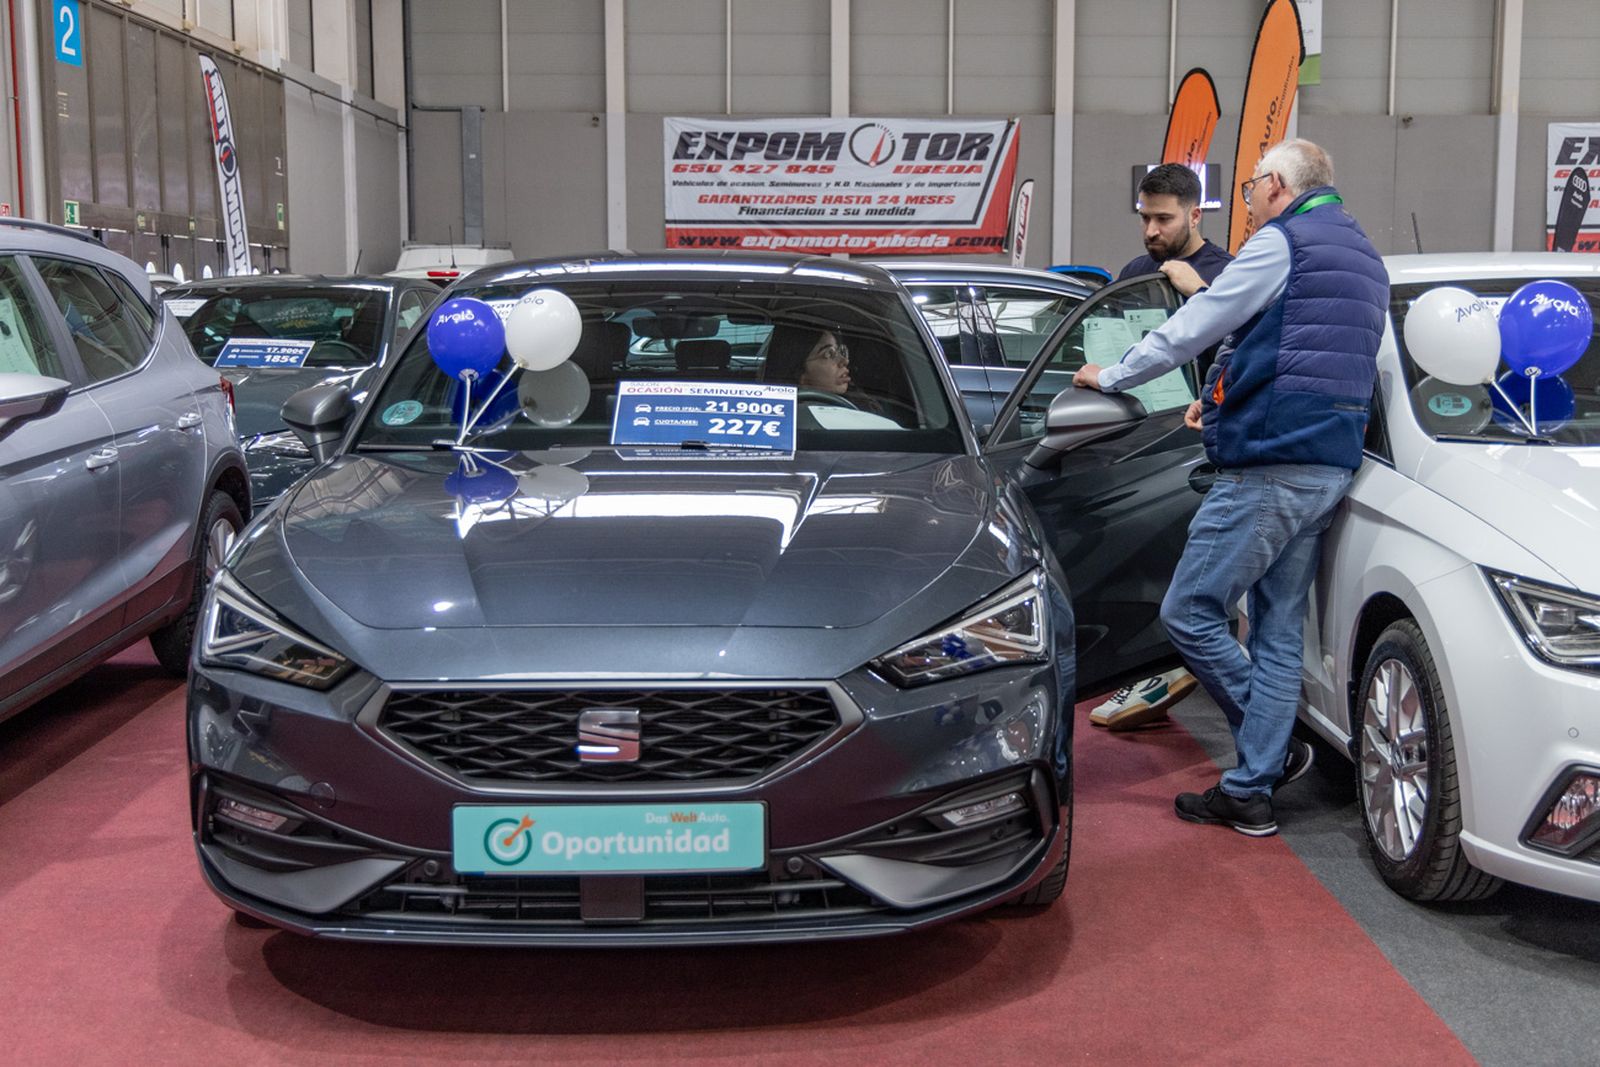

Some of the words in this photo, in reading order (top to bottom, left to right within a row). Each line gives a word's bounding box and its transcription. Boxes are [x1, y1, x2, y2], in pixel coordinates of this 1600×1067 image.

[60, 5, 76, 56] 2
[672, 164, 723, 174] 650
[729, 164, 779, 174] 427
[784, 164, 837, 174] 845
[892, 164, 984, 174] UBEDA
[698, 194, 817, 204] GARANTIZADOS
[821, 195, 872, 205] HASTA
[877, 195, 900, 204] 24
[904, 195, 956, 205] MESES
[738, 206, 826, 216] Financiacion
[829, 208, 839, 216] a
[842, 208, 860, 216] su
[865, 206, 916, 216] medida
[627, 386, 683, 394] OCASIÓN
[689, 387, 763, 397] SEMINUEVO
[705, 401, 785, 415] 21.900€
[708, 418, 781, 437] 227€
[645, 812, 668, 824] Das
[541, 827, 730, 860] Oportunidad
